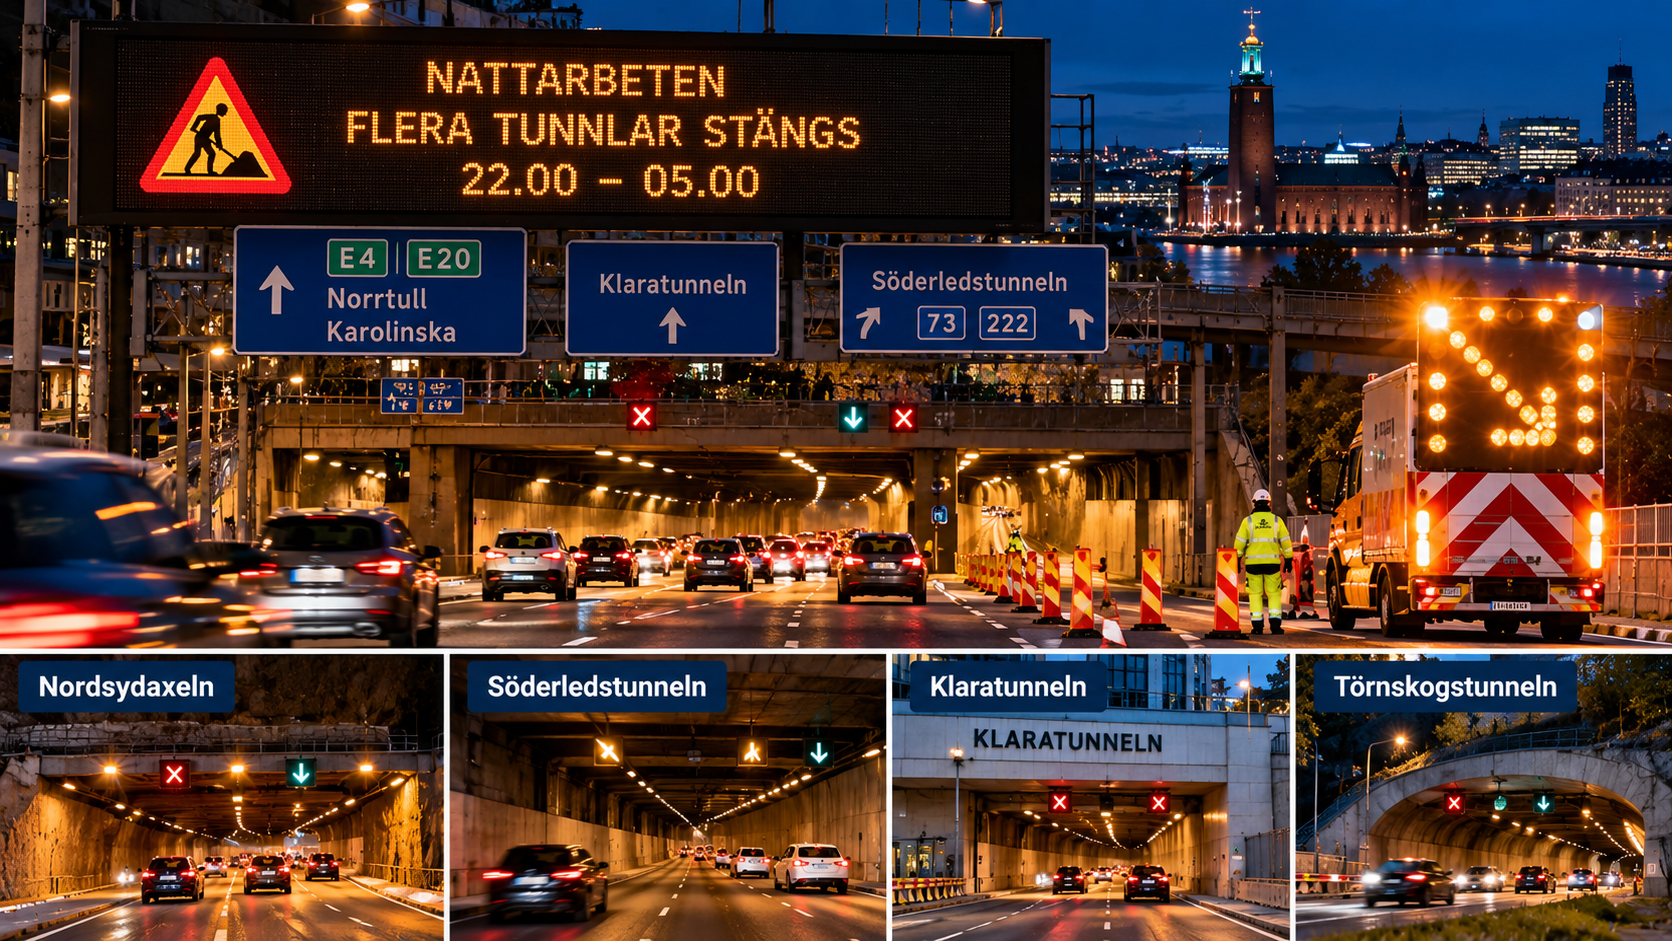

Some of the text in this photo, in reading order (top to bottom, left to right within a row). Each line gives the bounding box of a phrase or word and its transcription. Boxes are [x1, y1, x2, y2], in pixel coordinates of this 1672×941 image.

[427, 61, 724, 97] NATTARBETEN
[347, 108, 861, 149] FLERA TUNNLAR STÄNGS
[462, 162, 577, 196] 22.00
[644, 164, 759, 198] 05.00
[341, 247, 470, 269] E4 E20
[601, 274, 745, 294] Klaratunneln
[873, 271, 1066, 291] Söderledstunneln
[329, 288, 426, 309] Norrtull
[328, 321, 455, 342] Karolinska
[928, 314, 1027, 332] 73 222
[974, 729, 1161, 752] KLARATUNNELN
